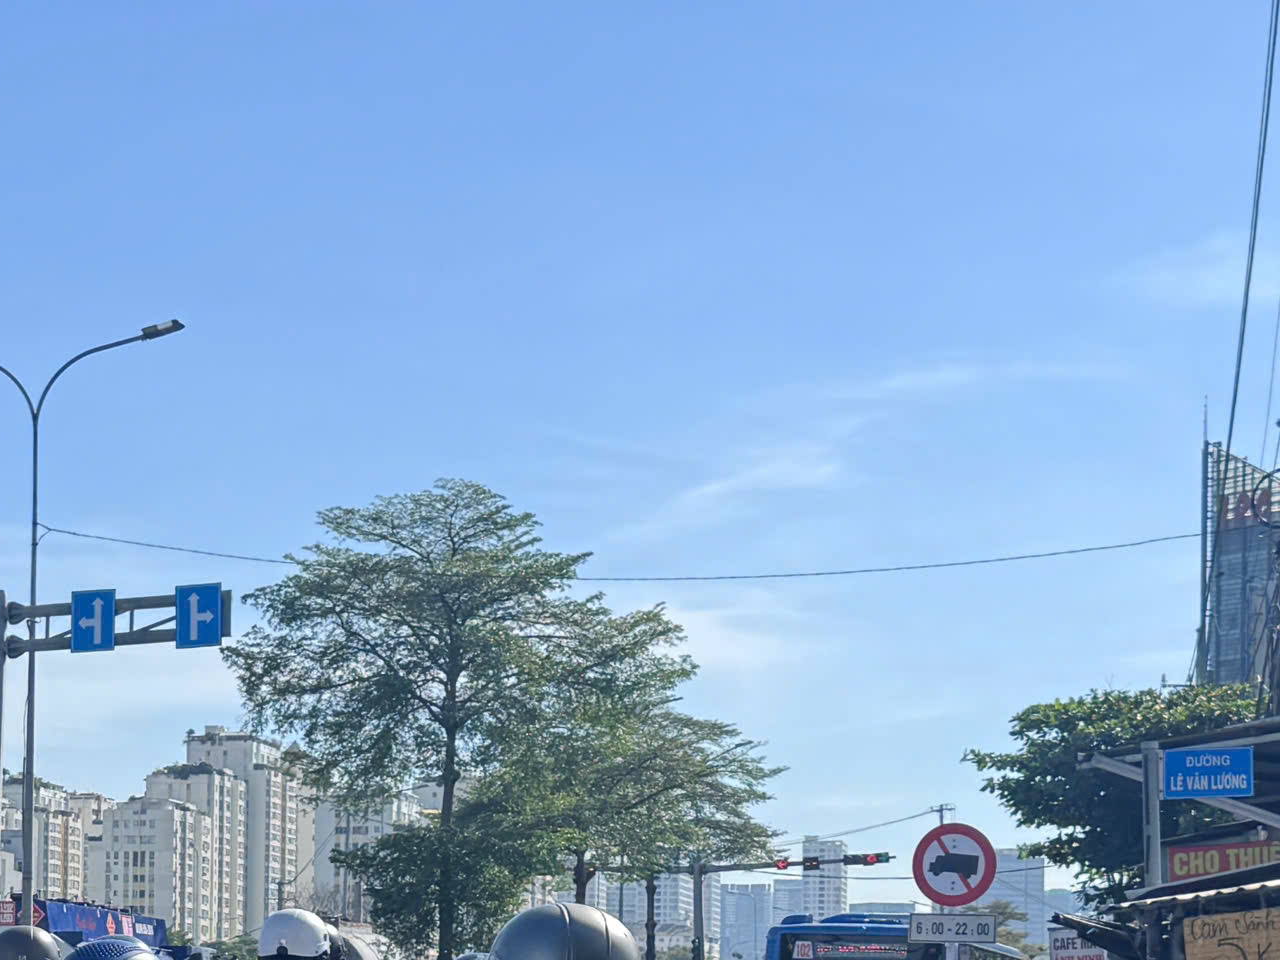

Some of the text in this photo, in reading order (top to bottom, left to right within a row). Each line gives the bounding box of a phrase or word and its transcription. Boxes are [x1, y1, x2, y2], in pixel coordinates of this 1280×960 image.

[1186, 753, 1231, 768] ĐƯỜNG
[1170, 770, 1248, 791] LÊ VĂN LƯƠNG
[1174, 850, 1220, 876] CHO
[795, 943, 811, 957] 102
[1053, 938, 1078, 951] CAFE
